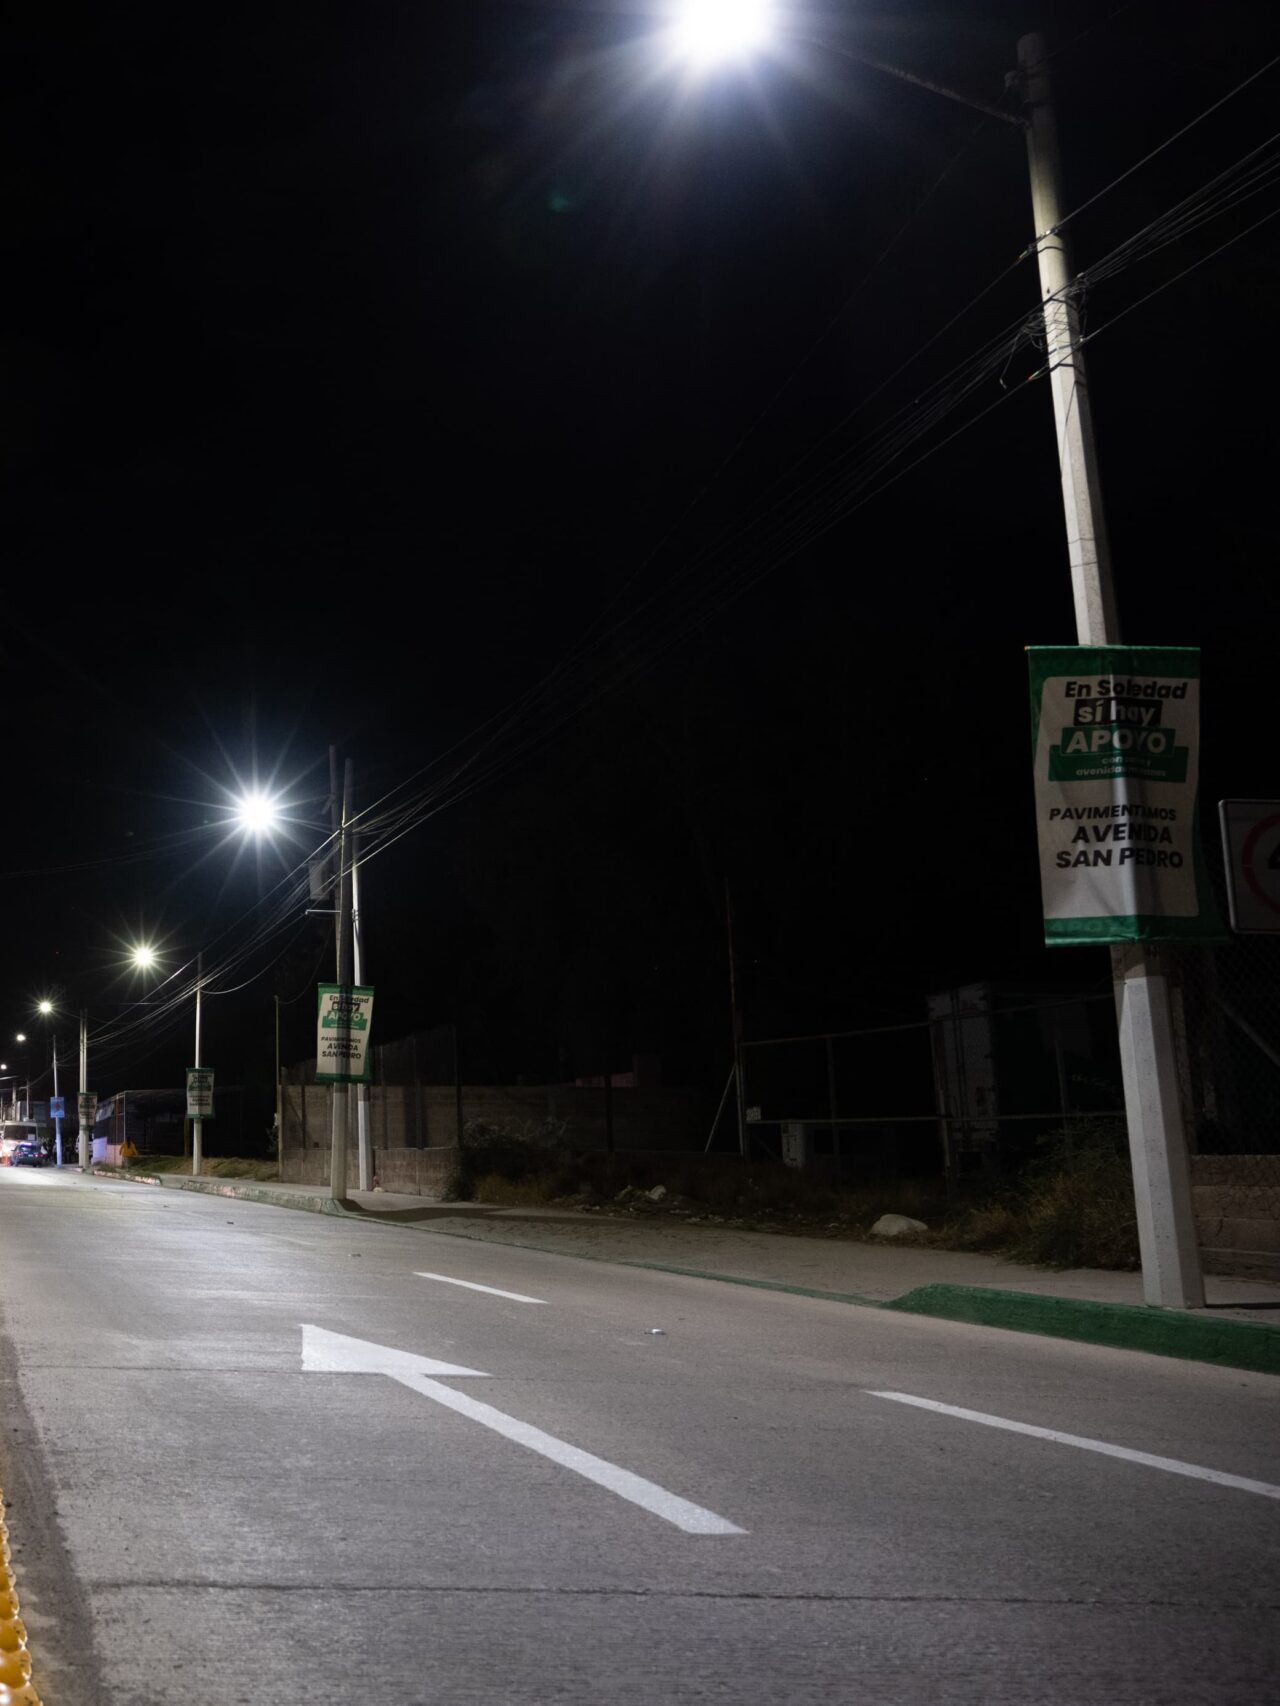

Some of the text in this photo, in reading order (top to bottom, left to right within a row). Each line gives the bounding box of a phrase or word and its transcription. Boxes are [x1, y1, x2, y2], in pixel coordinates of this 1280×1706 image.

[1064, 679, 1188, 699] En Soledad
[1066, 728, 1167, 754] APOYO
[1071, 822, 1173, 844] AVENIDA
[1056, 847, 1184, 869] SAN PEDRO
